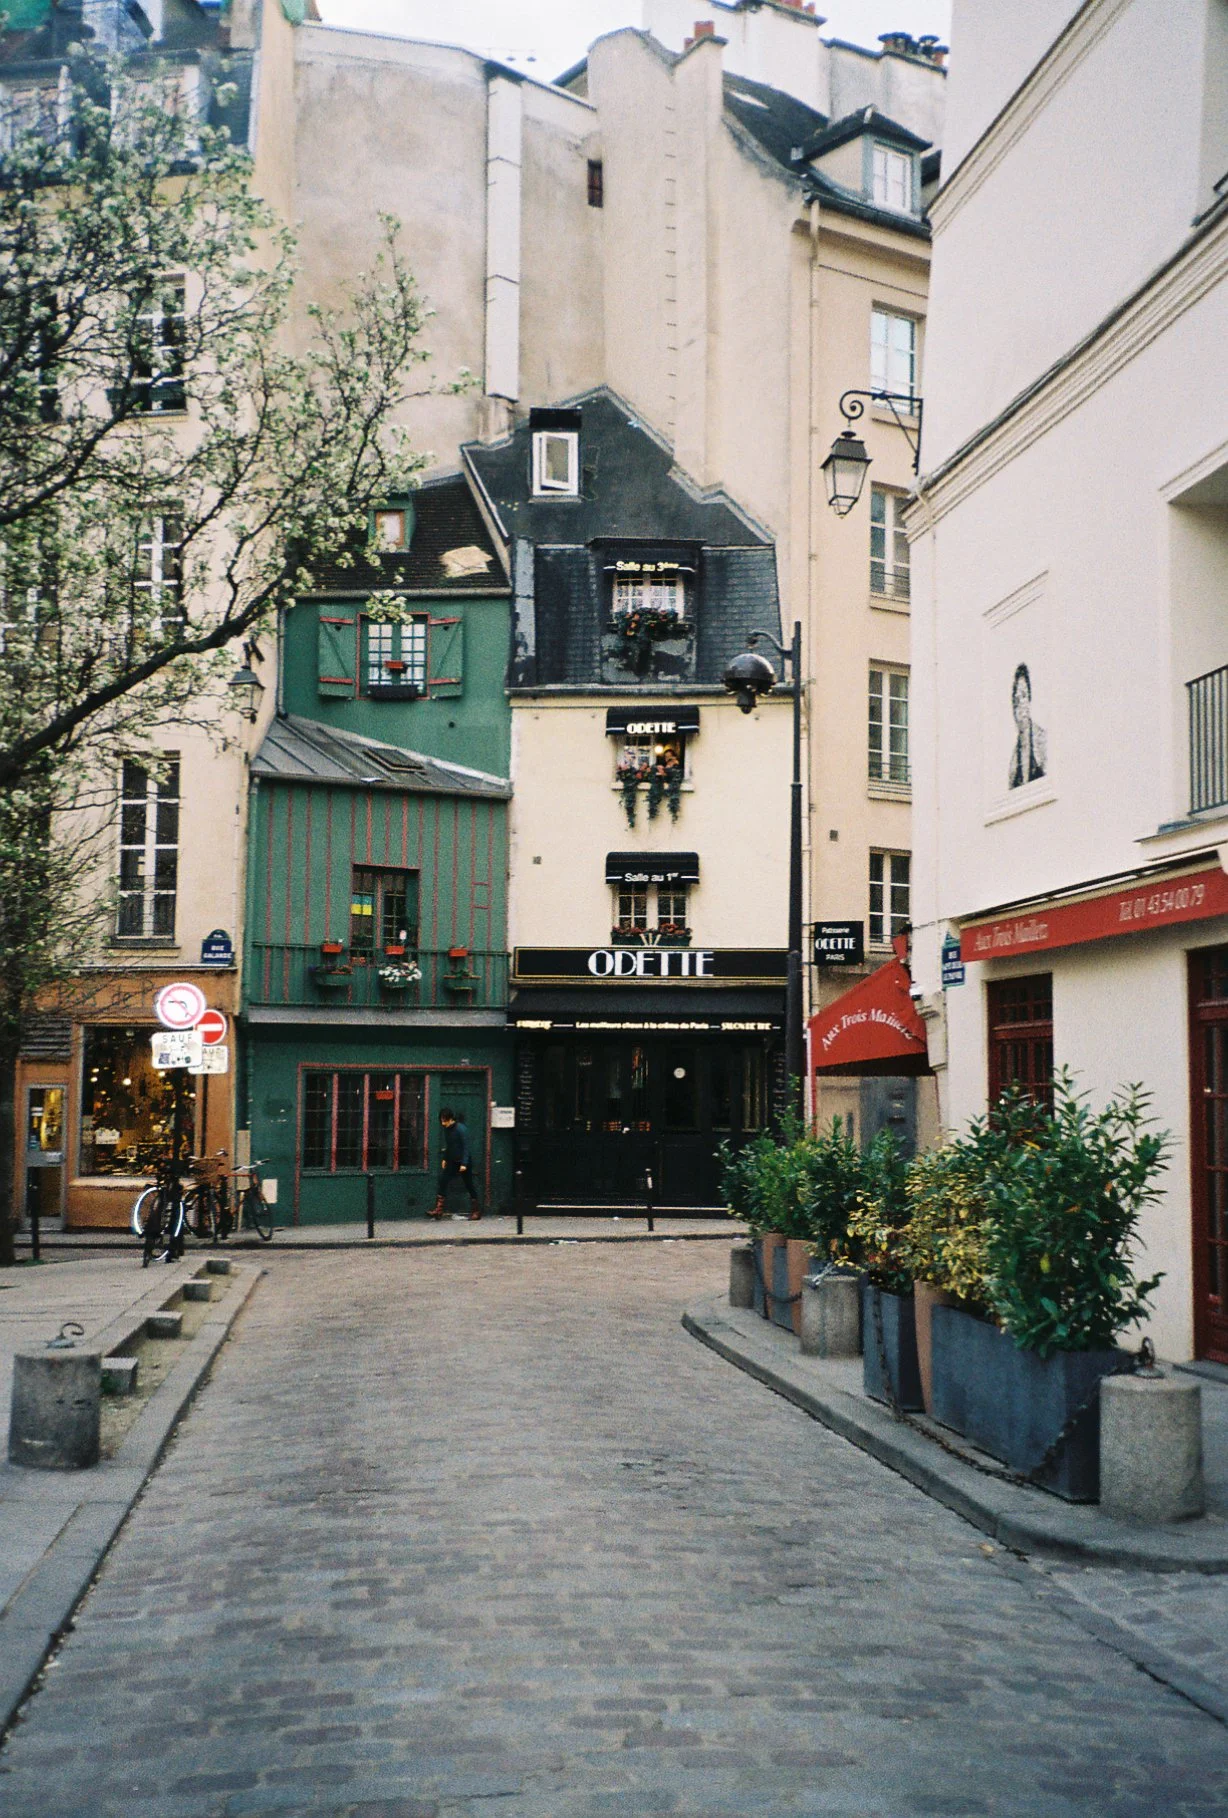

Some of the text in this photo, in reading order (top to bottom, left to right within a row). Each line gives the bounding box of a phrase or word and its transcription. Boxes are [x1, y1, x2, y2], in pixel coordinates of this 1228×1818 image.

[616, 560, 640, 571] Salle
[626, 722, 677, 734] ODETTE
[624, 872, 649, 881] Salle
[814, 937, 856, 950] ODETTE
[825, 953, 845, 961] PARIS
[588, 950, 715, 976] ODETTE
[822, 1024, 841, 1052] Aux
[841, 1009, 868, 1030] Trois
[163, 1033, 193, 1043] SAUF
